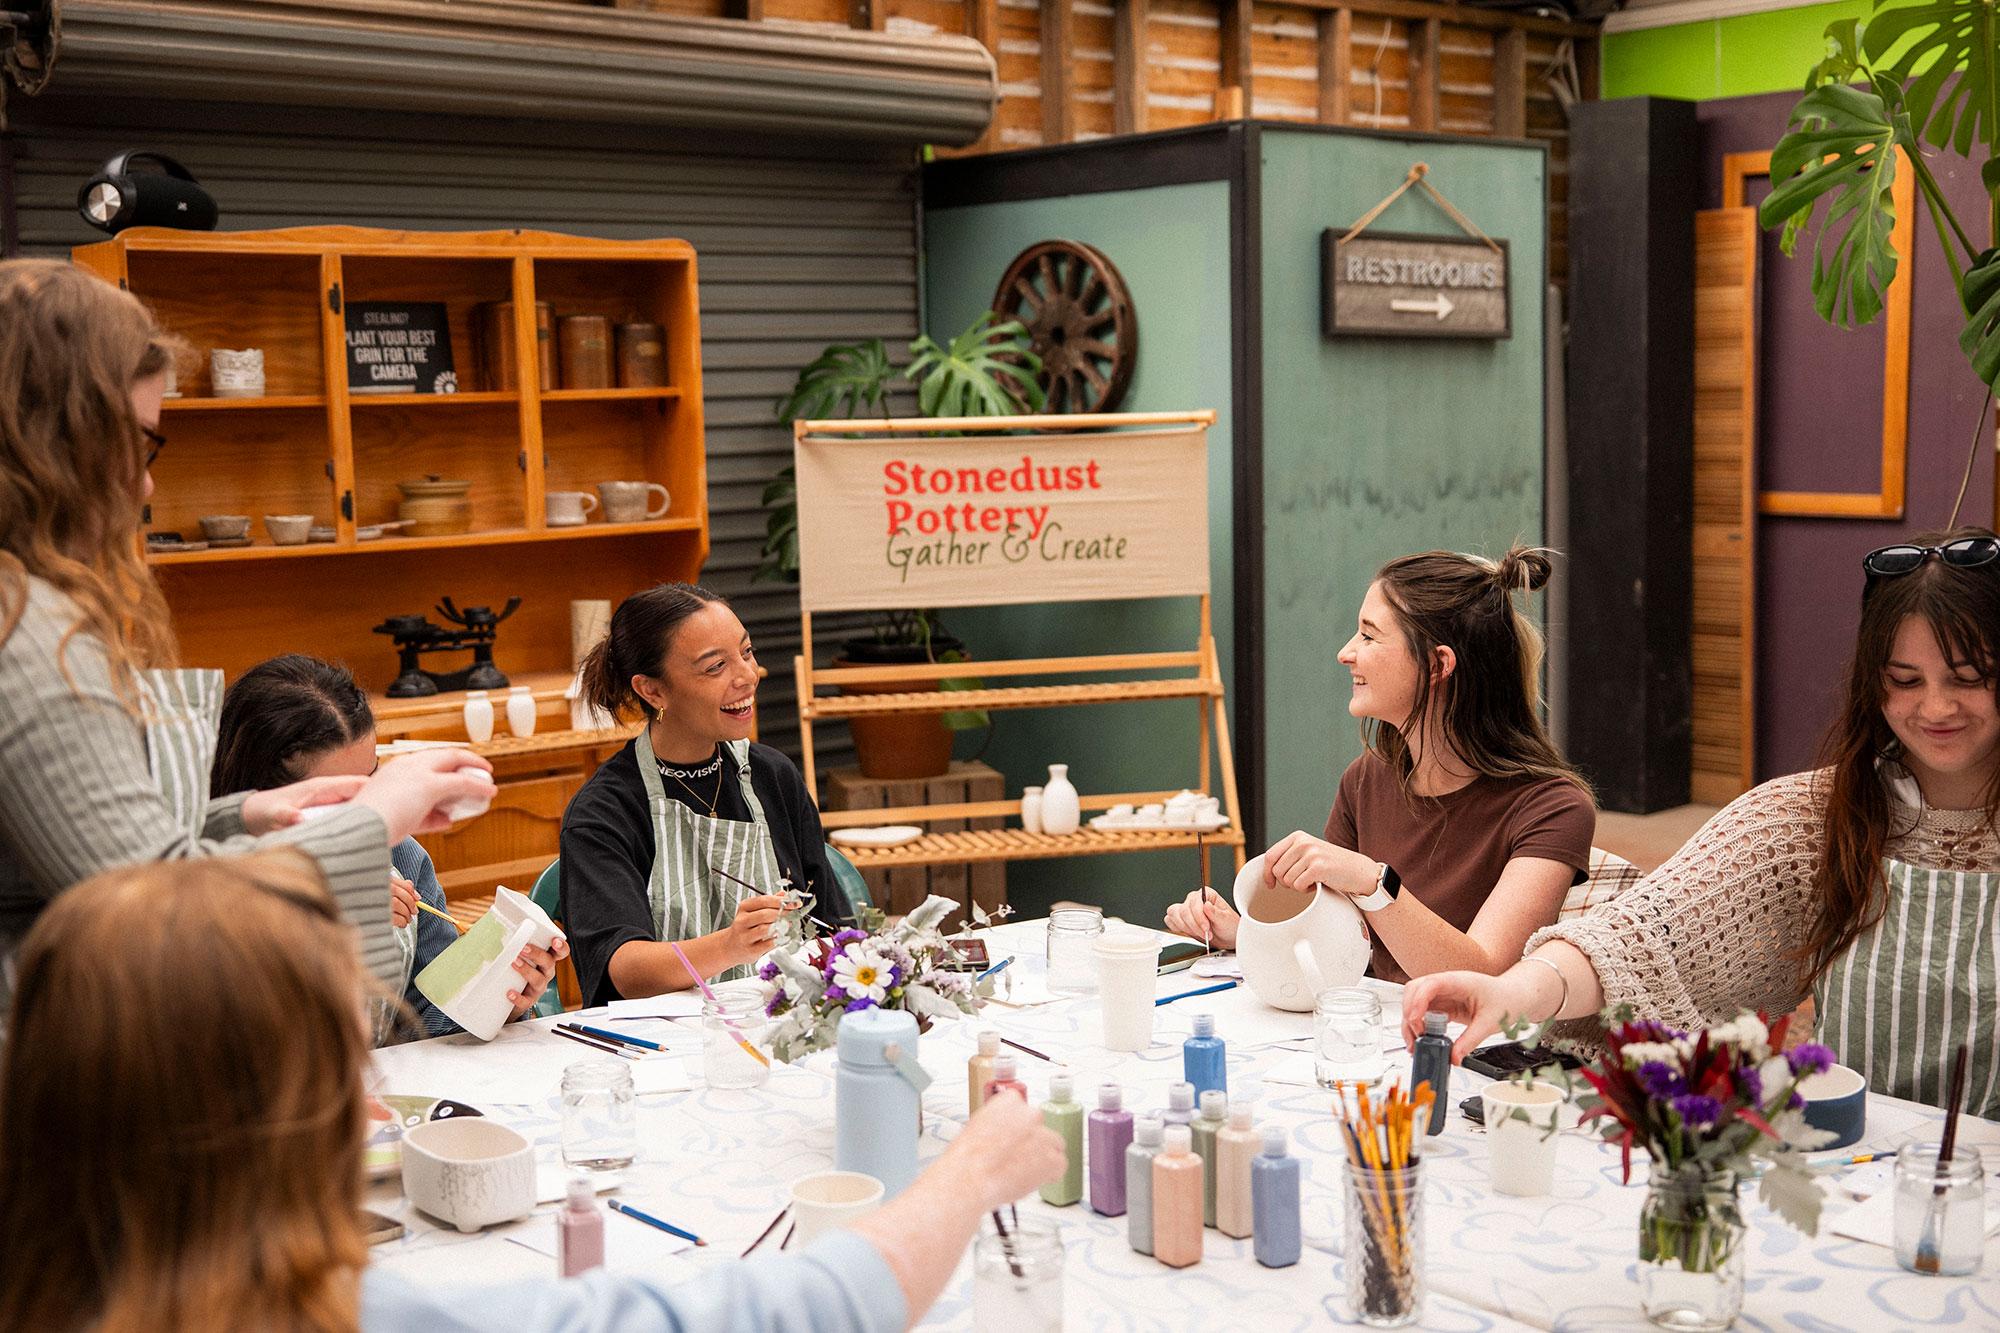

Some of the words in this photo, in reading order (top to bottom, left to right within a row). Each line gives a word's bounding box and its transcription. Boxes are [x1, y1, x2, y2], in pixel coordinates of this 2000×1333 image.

[1346, 255, 1497, 289] RESTROOMS
[364, 312, 409, 325] STEALING?
[378, 330, 409, 346] YOUR
[409, 330, 436, 346] BEST
[355, 347, 382, 364] GRIN
[383, 347, 405, 363] FOR
[406, 346, 428, 363] THE
[371, 363, 418, 381] CAMERA
[884, 456, 1101, 496] Stonedust
[886, 500, 1050, 541] Pottery
[887, 526, 991, 583] Gather
[1001, 523, 1030, 562] &
[1041, 522, 1128, 562] Create
